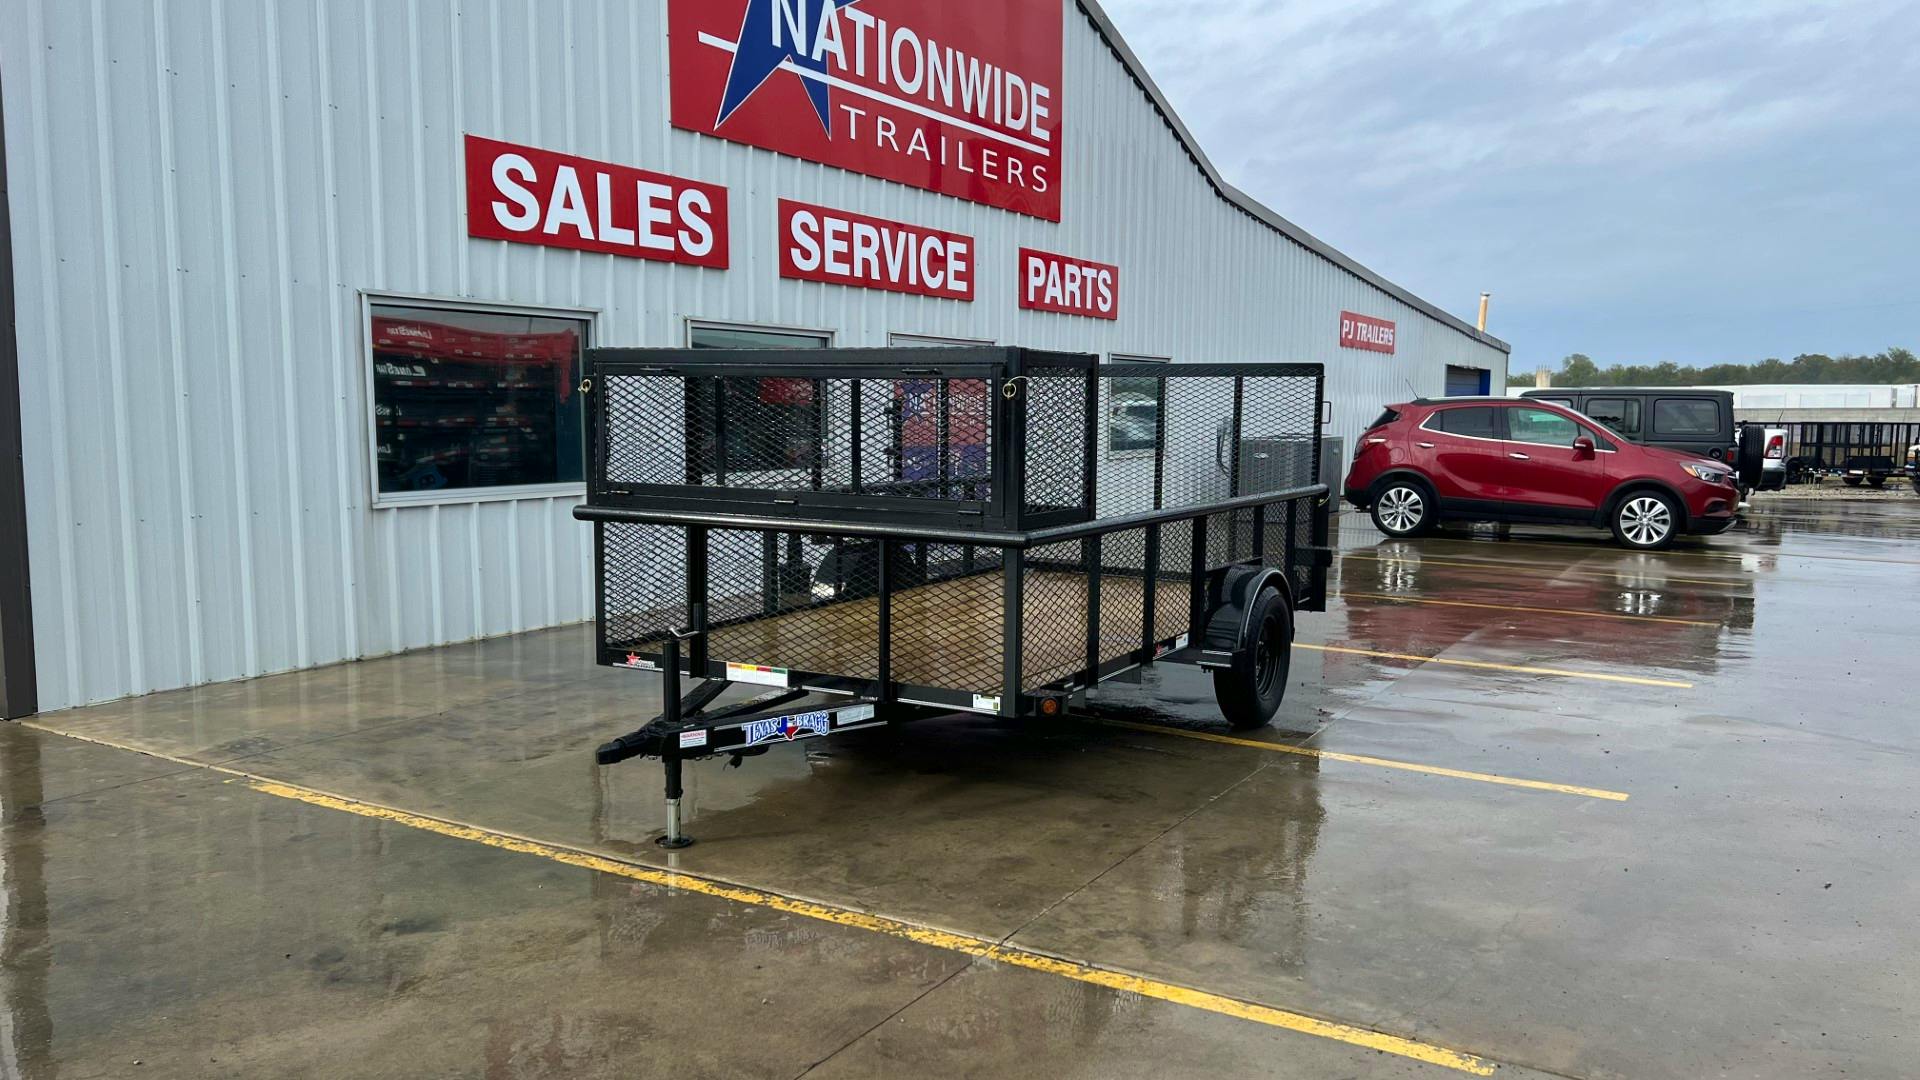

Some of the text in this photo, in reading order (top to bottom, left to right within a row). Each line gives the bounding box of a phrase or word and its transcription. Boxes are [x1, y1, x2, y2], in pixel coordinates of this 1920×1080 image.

[772, 0, 1050, 142] NATIONWIDE
[839, 104, 1048, 193] TRAILERS
[491, 153, 713, 257] SALES
[790, 210, 967, 292] SERVICE
[1027, 257, 1112, 312] PARTS
[1342, 319, 1394, 346] PJ TRAILERS
[743, 719, 778, 745] TEXAS
[797, 711, 830, 736] BRAGG
